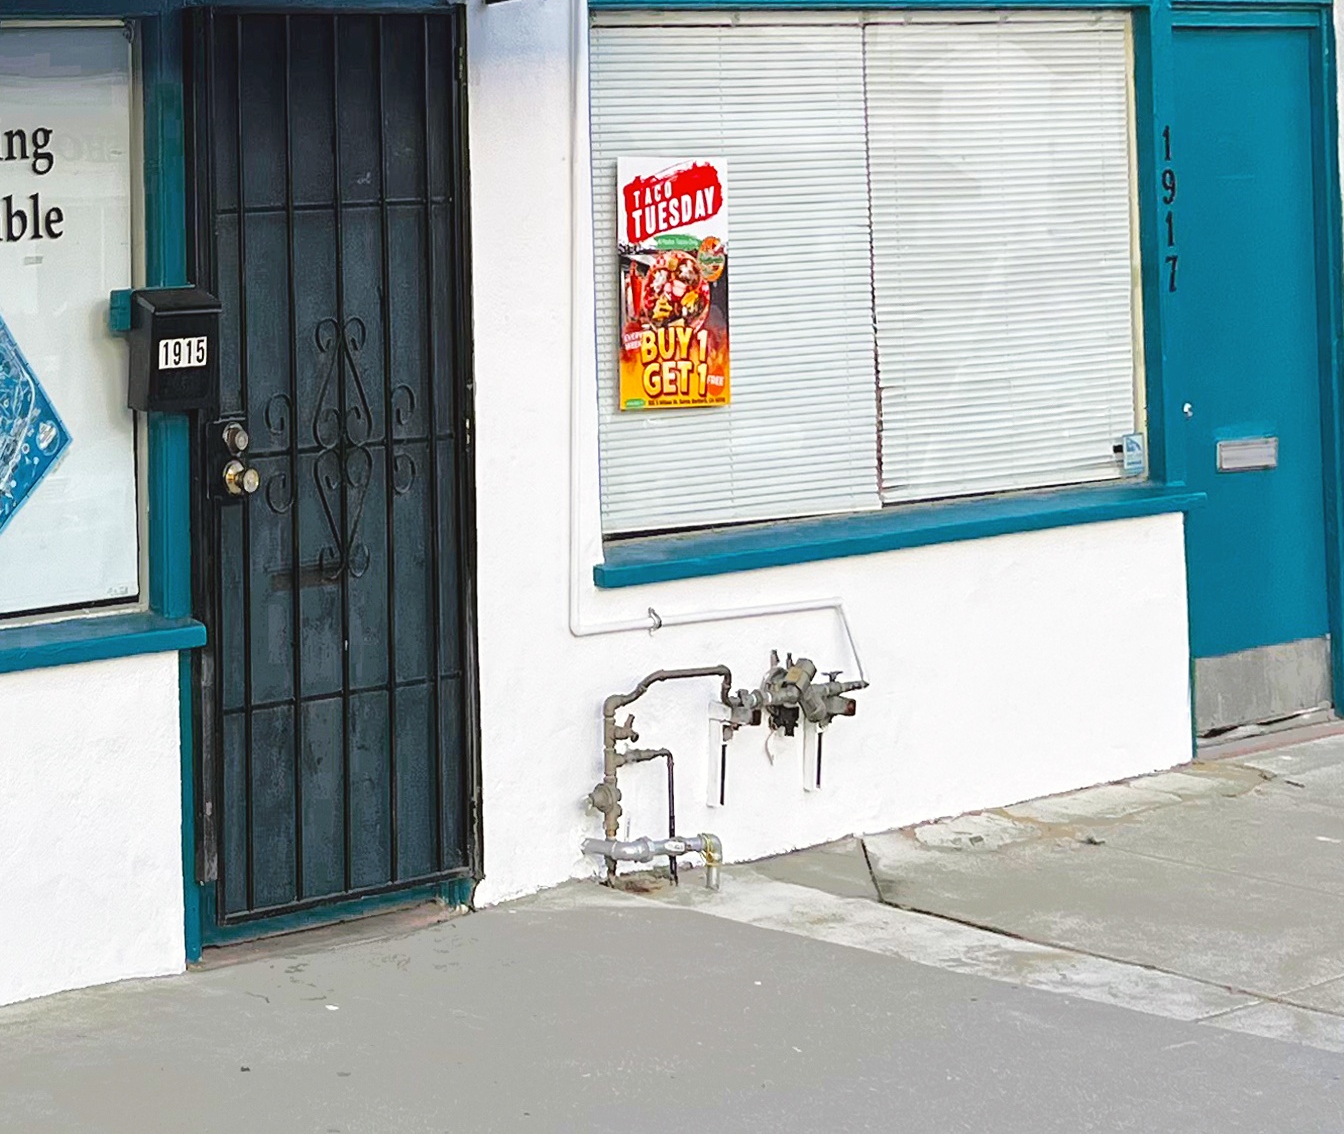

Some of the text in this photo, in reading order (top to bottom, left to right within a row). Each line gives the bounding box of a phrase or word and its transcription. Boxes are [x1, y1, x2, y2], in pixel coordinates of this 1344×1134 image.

[632, 186, 715, 238] TUESDAY
[633, 181, 673, 209] TACO
[1162, 125, 1179, 293] 1917
[163, 339, 205, 366] 1915
[640, 326, 708, 365] BUY 1
[642, 360, 708, 398] GET 1
[706, 374, 725, 386] FREE
